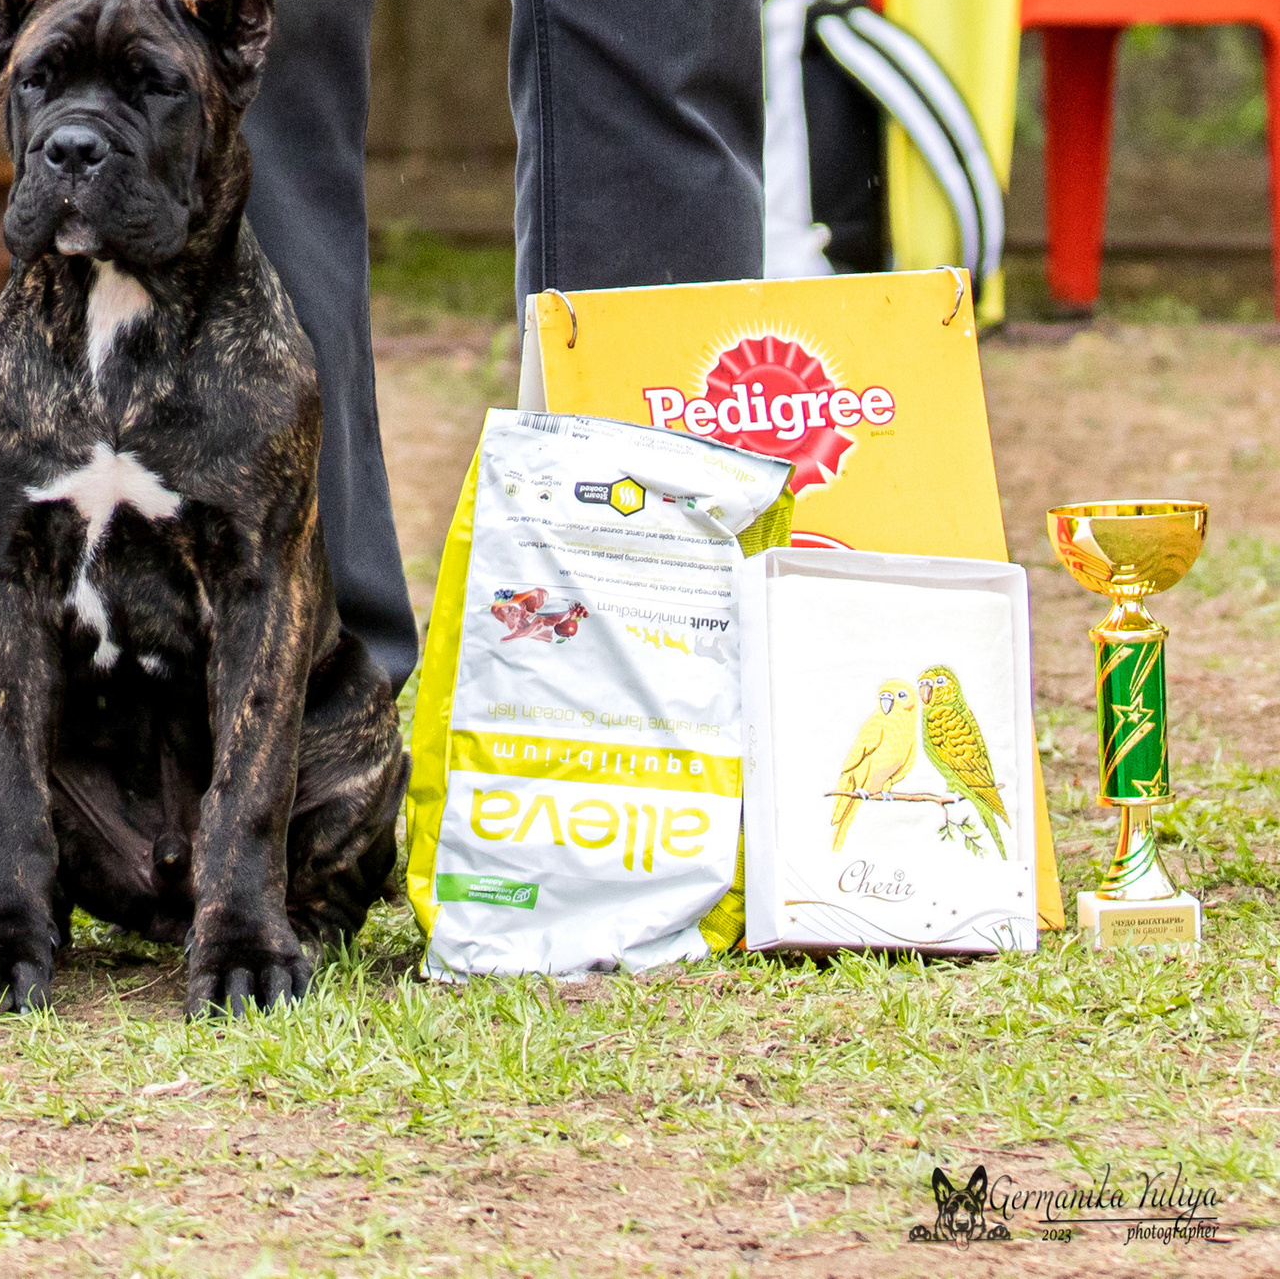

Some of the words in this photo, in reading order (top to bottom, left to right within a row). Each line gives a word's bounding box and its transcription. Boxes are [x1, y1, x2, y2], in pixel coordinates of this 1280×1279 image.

[644, 383, 896, 440] Pedigree
[870, 429, 895, 437] BRAND
[703, 454, 756, 483] alleva
[580, 485, 609, 493] Cooked
[584, 492, 609, 500] Steam
[506, 515, 520, 523] fiber
[600, 526, 624, 535] sources
[659, 532, 676, 541] apple
[519, 541, 539, 549] health
[539, 542, 556, 550] heart
[566, 548, 590, 556] taurine
[591, 551, 605, 560] plus
[606, 552, 624, 561] joints
[625, 554, 660, 565] supporting
[660, 559, 719, 572] chondroprotectors
[720, 565, 733, 573] With
[573, 570, 597, 581] healthy
[605, 577, 648, 589] maintenance
[648, 583, 658, 591] for
[677, 586, 693, 595] fatty
[694, 588, 717, 596] omega
[718, 590, 732, 598] With
[597, 601, 687, 623] mini/medium
[689, 616, 730, 632] Adult
[487, 702, 518, 720] fish
[520, 705, 575, 722] ocean
[580, 710, 595, 727] &
[600, 711, 643, 731] lamb
[648, 715, 720, 737] sensitive
[493, 741, 704, 775] equilibrium
[470, 788, 710, 873] alleva
[479, 878, 504, 886] Added
[838, 860, 916, 902] Cherir
[468, 891, 494, 900] Natural
[1137, 917, 1185, 925] БОГАТЫРИ»
